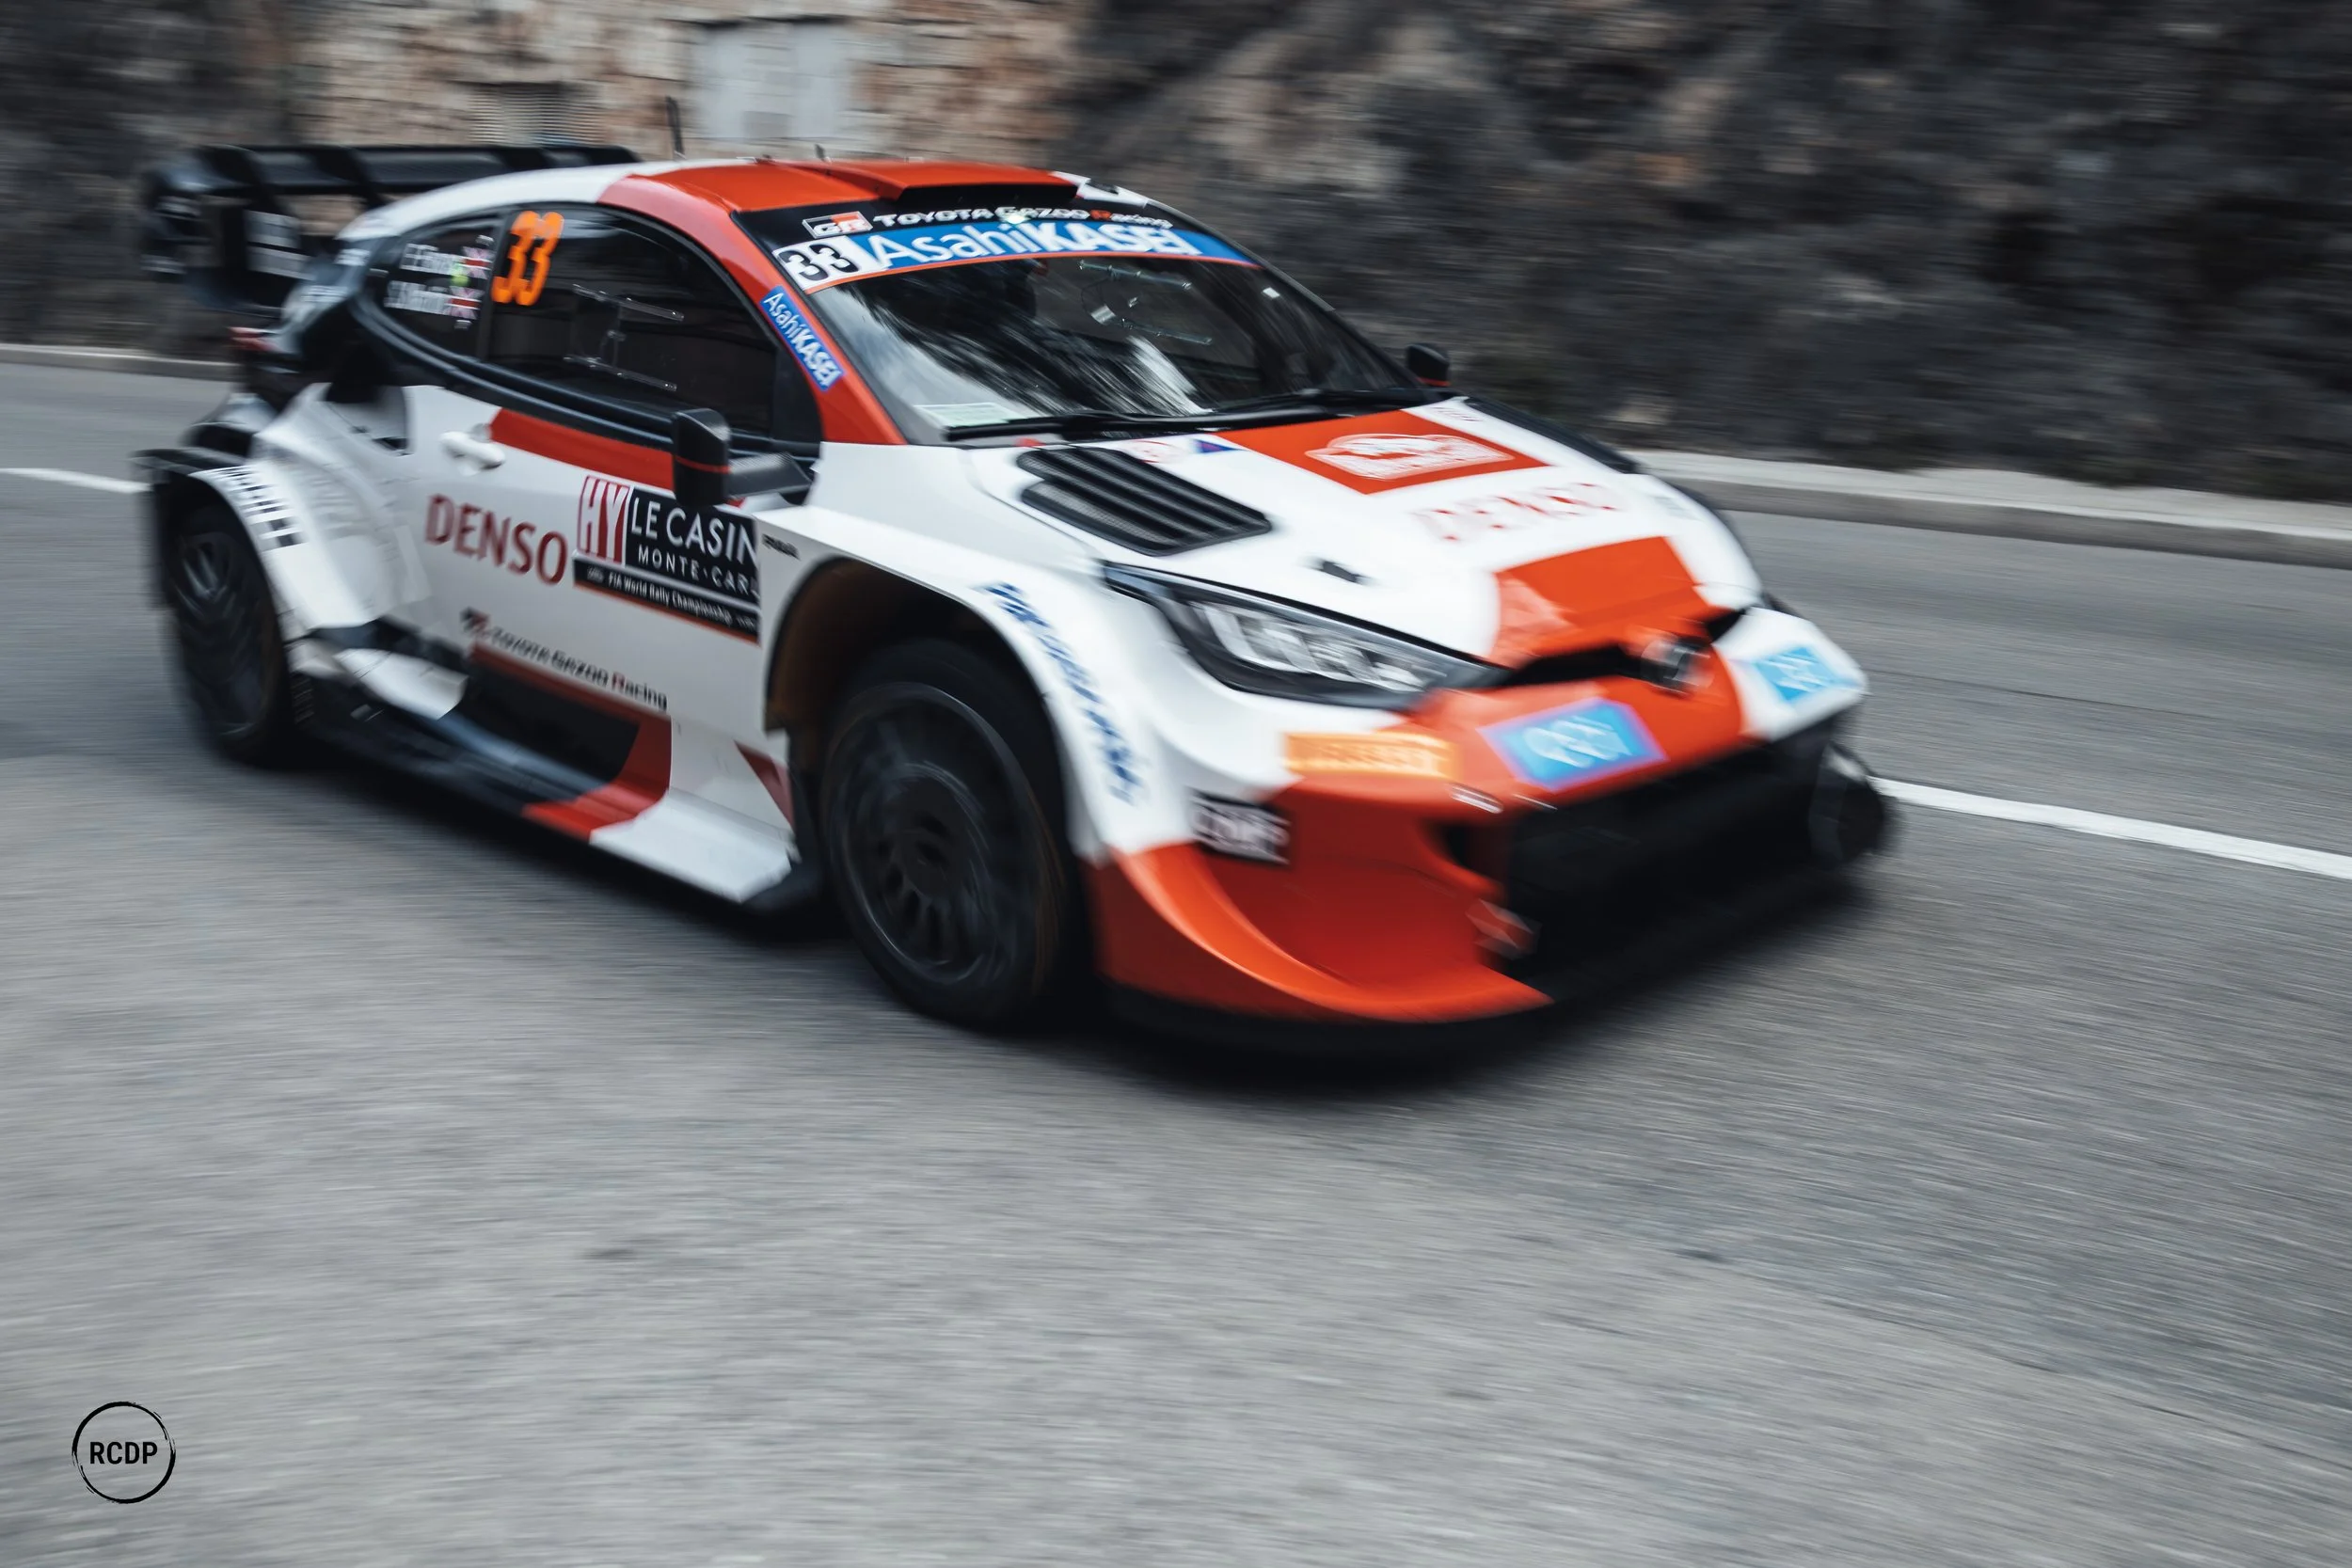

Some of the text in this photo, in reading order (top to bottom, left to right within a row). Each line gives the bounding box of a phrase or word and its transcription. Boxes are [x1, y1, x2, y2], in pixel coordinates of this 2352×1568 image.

[873, 209, 994, 227] TOYOTA
[491, 210, 564, 307] 33
[777, 243, 859, 281] 33
[630, 497, 661, 540] LE
[425, 492, 568, 587] DENSO
[608, 571, 623, 589] FIA
[624, 576, 647, 596] World
[649, 583, 671, 606] Rally
